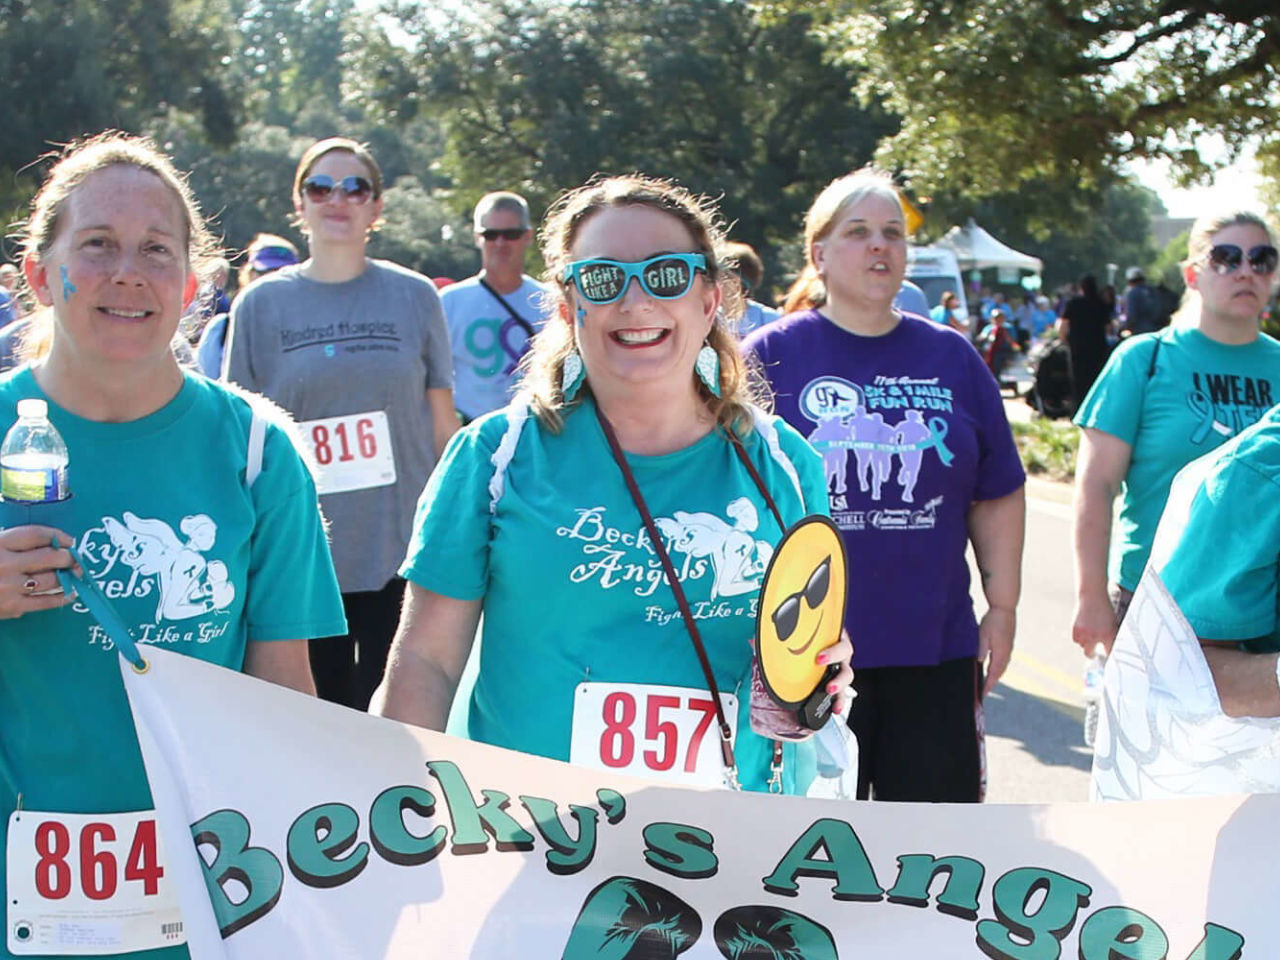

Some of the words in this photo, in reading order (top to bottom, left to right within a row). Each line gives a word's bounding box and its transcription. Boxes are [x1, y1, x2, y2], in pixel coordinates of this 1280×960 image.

[581, 267, 619, 288] FIGHT
[647, 267, 686, 289] GIRL
[585, 284, 610, 299] LIKE
[609, 282, 618, 295] A
[914, 385, 953, 401] MILE
[1205, 373, 1274, 408] WEAR
[868, 396, 910, 410] FUN
[911, 396, 954, 414] RUN
[312, 418, 377, 465] 816
[693, 601, 732, 620] Like
[735, 606, 744, 616] a
[137, 623, 180, 643] Like
[183, 631, 194, 642] a
[197, 621, 230, 643] Girl
[599, 691, 718, 773] 857
[34, 819, 165, 901] 864
[189, 760, 719, 940] Becky's
